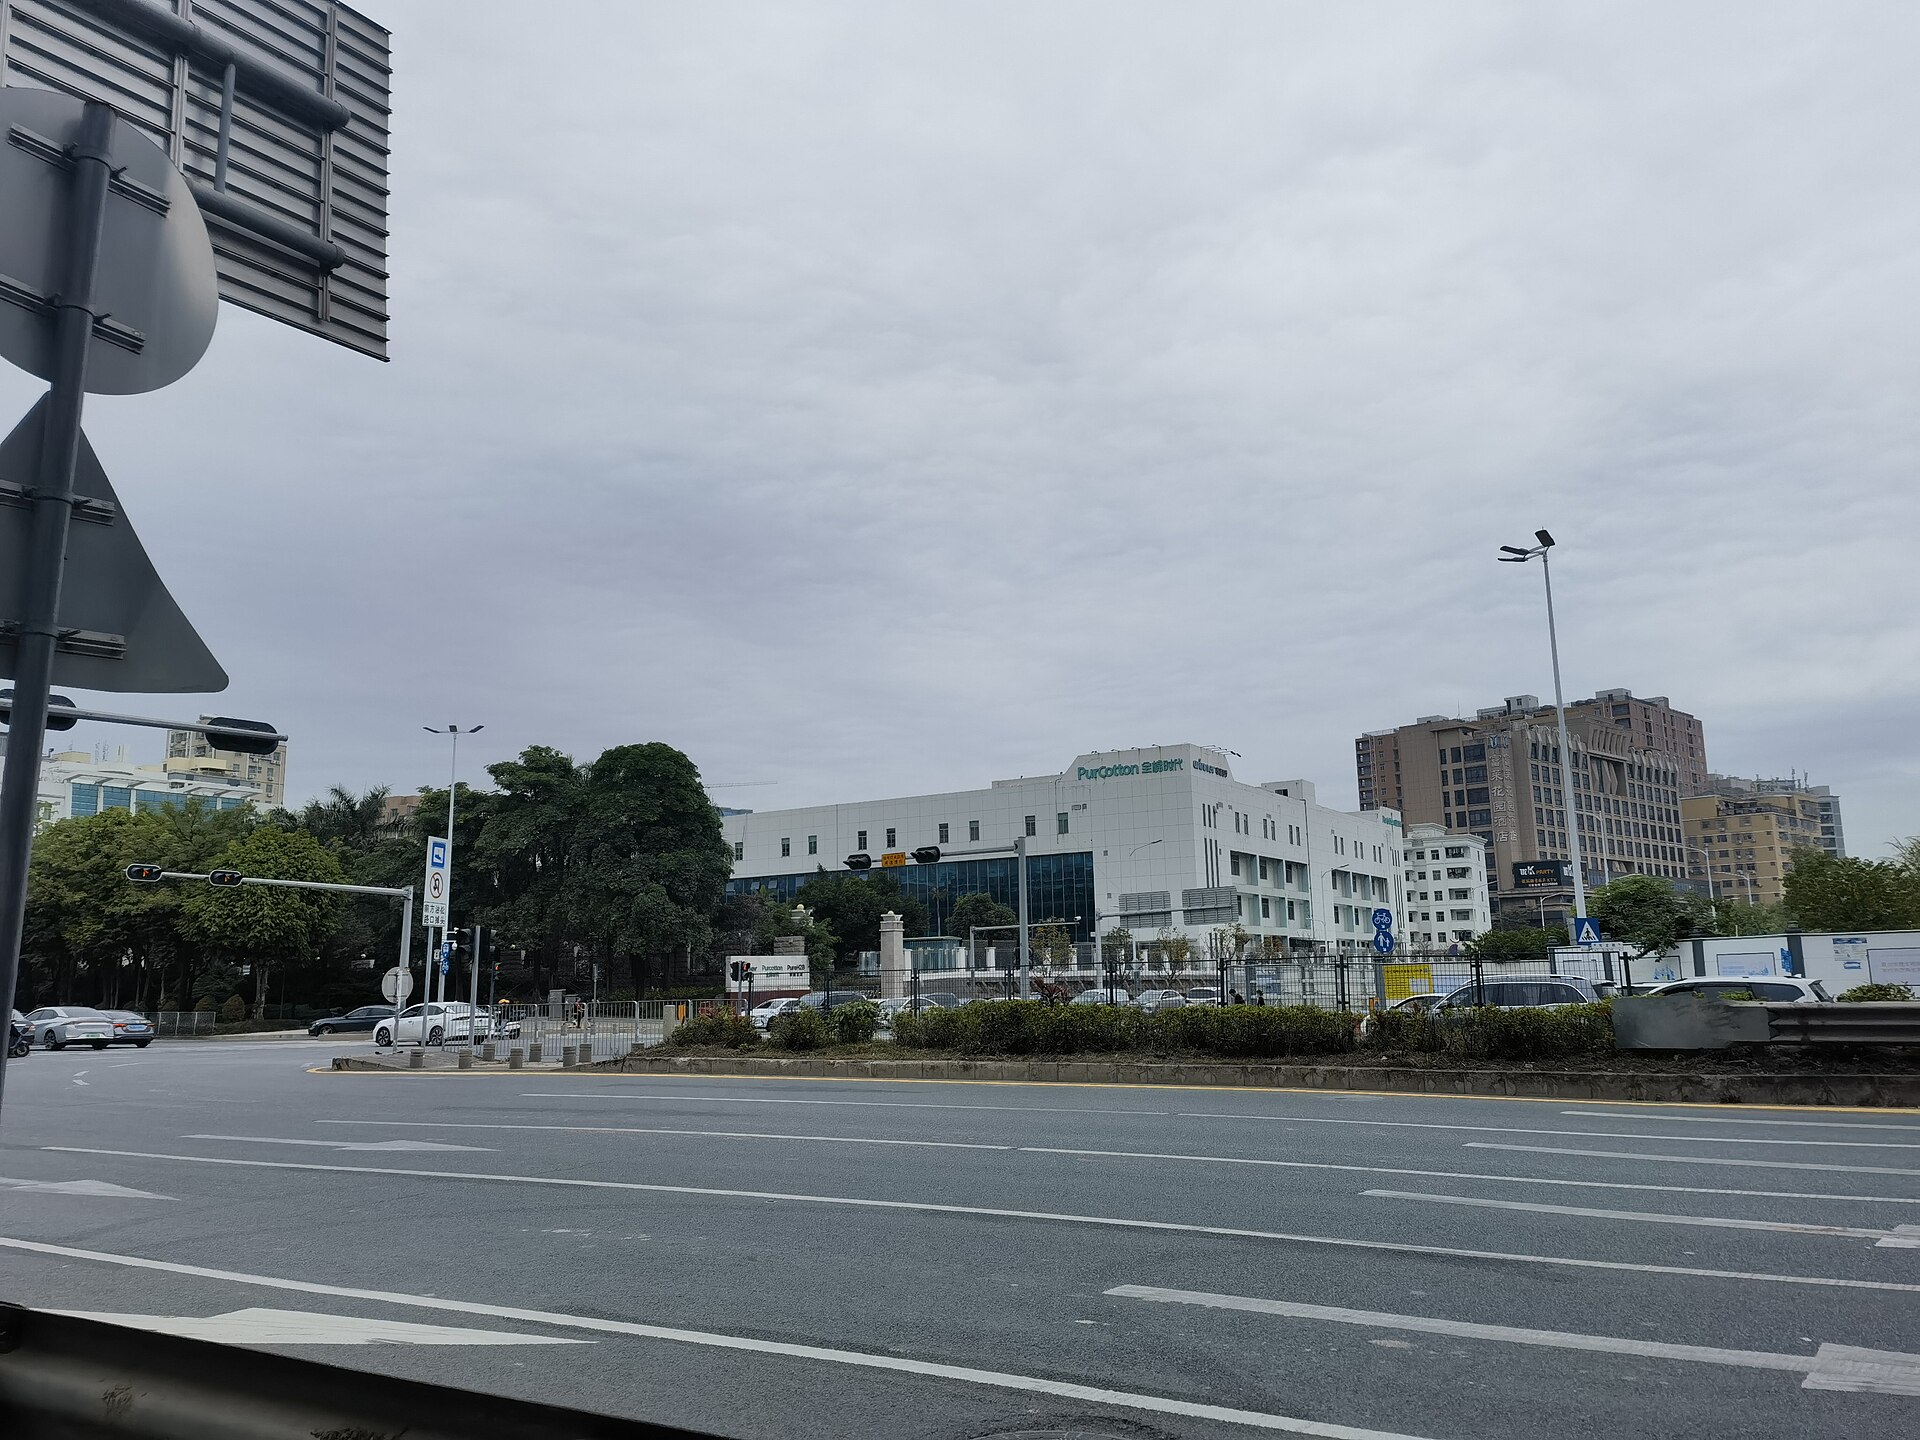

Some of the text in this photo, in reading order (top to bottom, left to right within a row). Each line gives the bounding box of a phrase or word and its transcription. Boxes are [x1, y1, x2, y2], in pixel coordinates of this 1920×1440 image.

[1077, 758, 1183, 780] PurCotton 全棉时代
